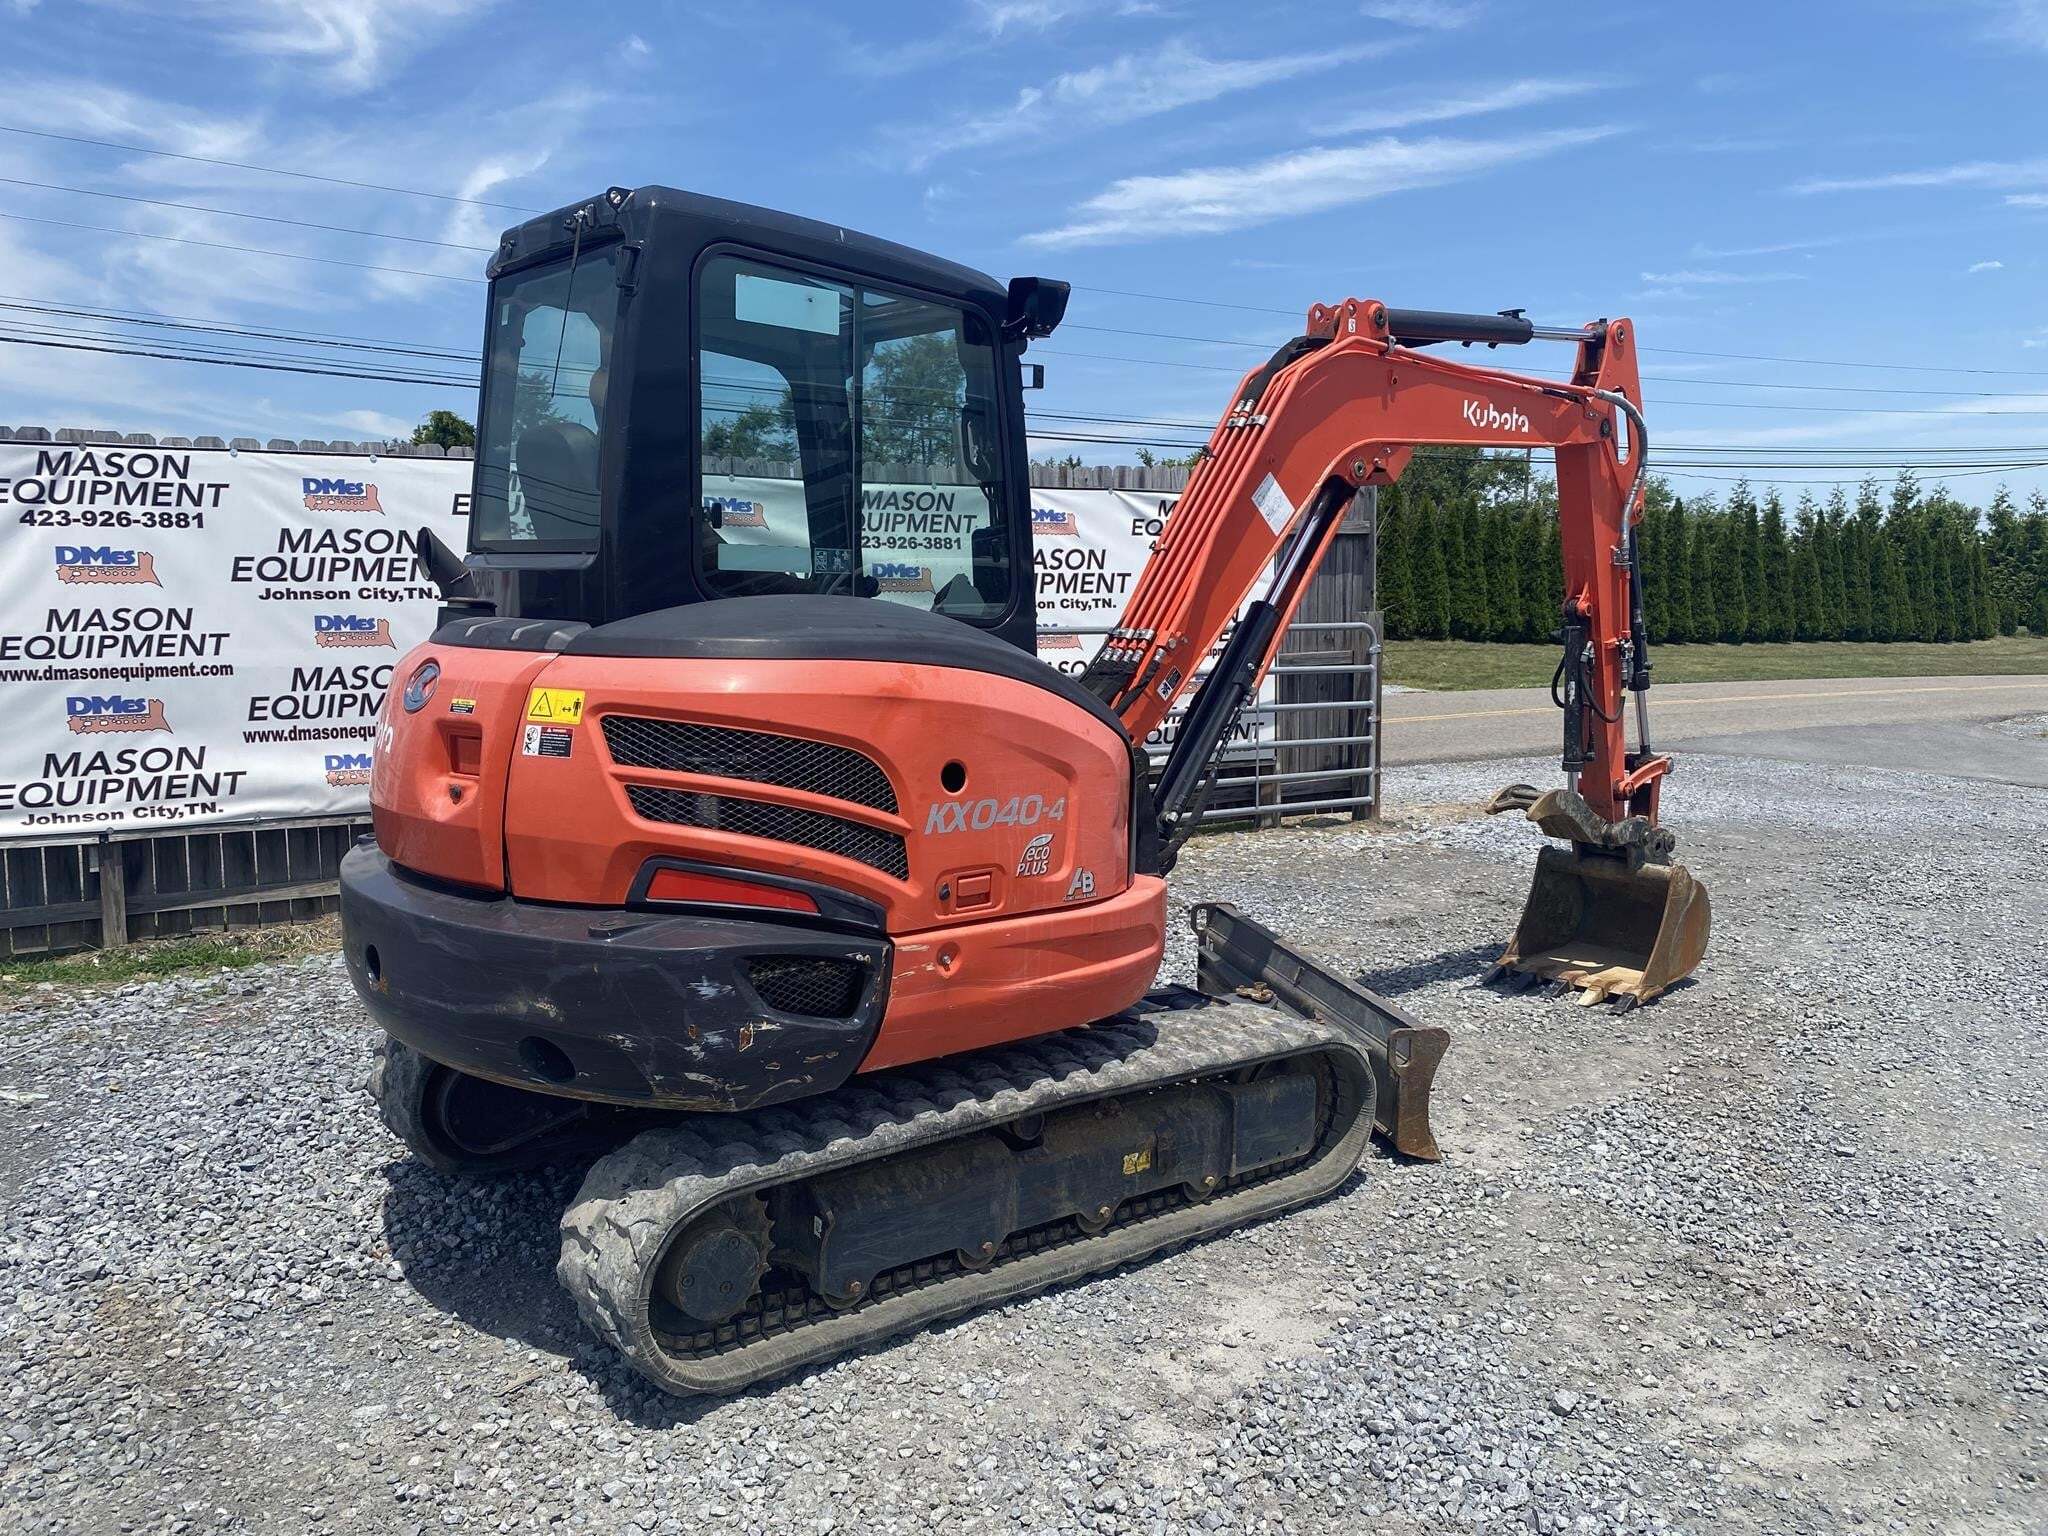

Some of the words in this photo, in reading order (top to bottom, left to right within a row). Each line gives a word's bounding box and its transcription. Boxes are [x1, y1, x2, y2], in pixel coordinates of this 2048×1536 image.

[1463, 399, 1529, 433] Kubota
[35, 450, 191, 479] MASON
[861, 490, 956, 512] MASON
[19, 509, 205, 529] 423-926-3881
[865, 512, 978, 533] UIPMENT
[278, 527, 418, 554] MASON
[861, 535, 962, 550] 23-926-3881
[1033, 548, 1107, 571] ASON
[258, 587, 357, 601] Johnson
[45, 607, 194, 633] MASON
[0, 632, 231, 661] EQUIPMENT
[0, 661, 234, 682] www.dmasonequipment.com
[291, 664, 395, 692] MASO
[247, 692, 386, 721] EQUIPM
[243, 725, 378, 744] www.dmasonequ
[42, 746, 207, 779] MASON
[21, 811, 124, 827] Johnson
[923, 794, 1066, 836] KX040-4
[1026, 845, 1051, 861] eco
[1015, 860, 1049, 877] PLUS
